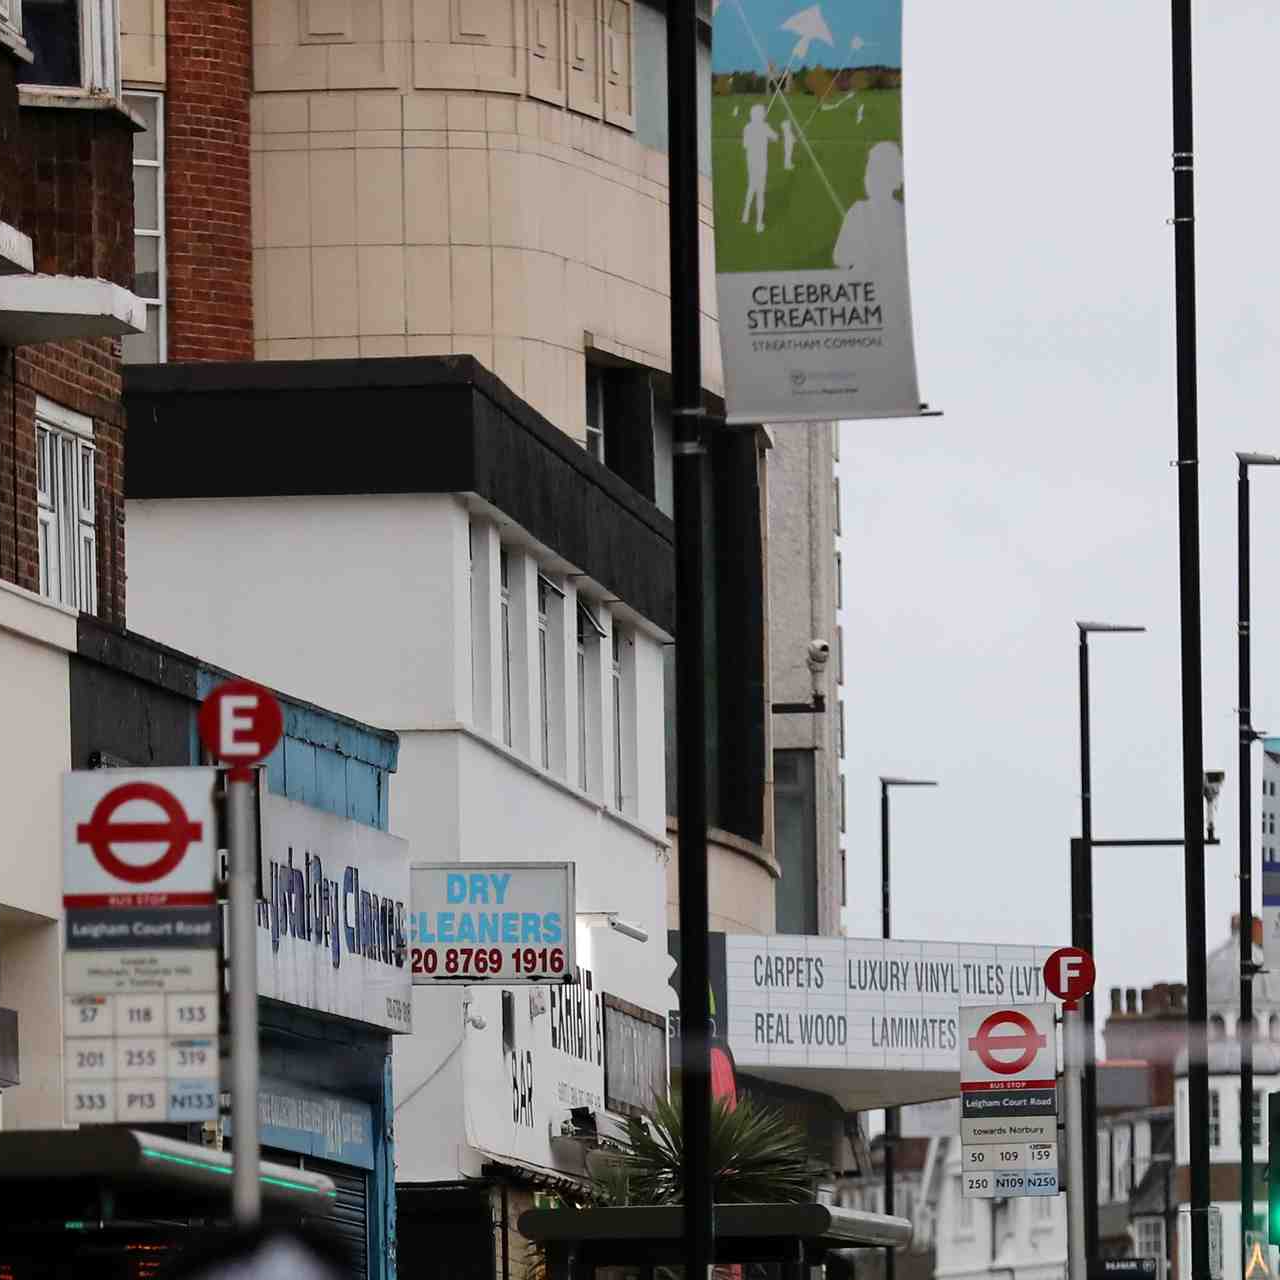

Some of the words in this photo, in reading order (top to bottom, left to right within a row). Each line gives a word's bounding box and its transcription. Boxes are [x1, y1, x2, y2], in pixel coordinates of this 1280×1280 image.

[751, 281, 876, 306] CELEBRATE
[746, 304, 883, 330] STREATHAM
[751, 339, 821, 352] STREATHAM
[220, 695, 259, 755] E
[446, 873, 512, 905] DRY
[444, 948, 503, 974] 8769
[511, 948, 564, 974] 1916
[753, 954, 824, 989] CARPETS
[848, 958, 910, 993] LUXURY
[915, 961, 959, 994] VINYL
[963, 963, 1004, 997] TILES
[1058, 956, 1083, 993] F
[128, 1007, 153, 1023] 118
[176, 1006, 207, 1023] 133
[754, 1012, 794, 1045] REAL
[799, 1013, 848, 1047] WOOD
[871, 1015, 957, 1051] LAMINATES
[76, 1052, 105, 1068] 201
[177, 1050, 207, 1067] 319
[511, 1050, 534, 1128] BAR
[1007, 1081, 1027, 1089] STOP
[127, 1093, 156, 1109] P13
[170, 1092, 215, 1108] N133
[965, 1099, 1001, 1109] Leigham
[1002, 1097, 1027, 1107] Court
[1029, 1097, 1052, 1106] Road
[973, 1126, 1007, 1136] towards
[1009, 1125, 1045, 1136] Norbury
[970, 1152, 985, 1162] 50
[999, 1151, 1019, 1161] 109
[1031, 1150, 1051, 1161] 159
[968, 1178, 989, 1189] 250
[995, 1177, 1024, 1188] N109
[1027, 1176, 1057, 1187] N250
